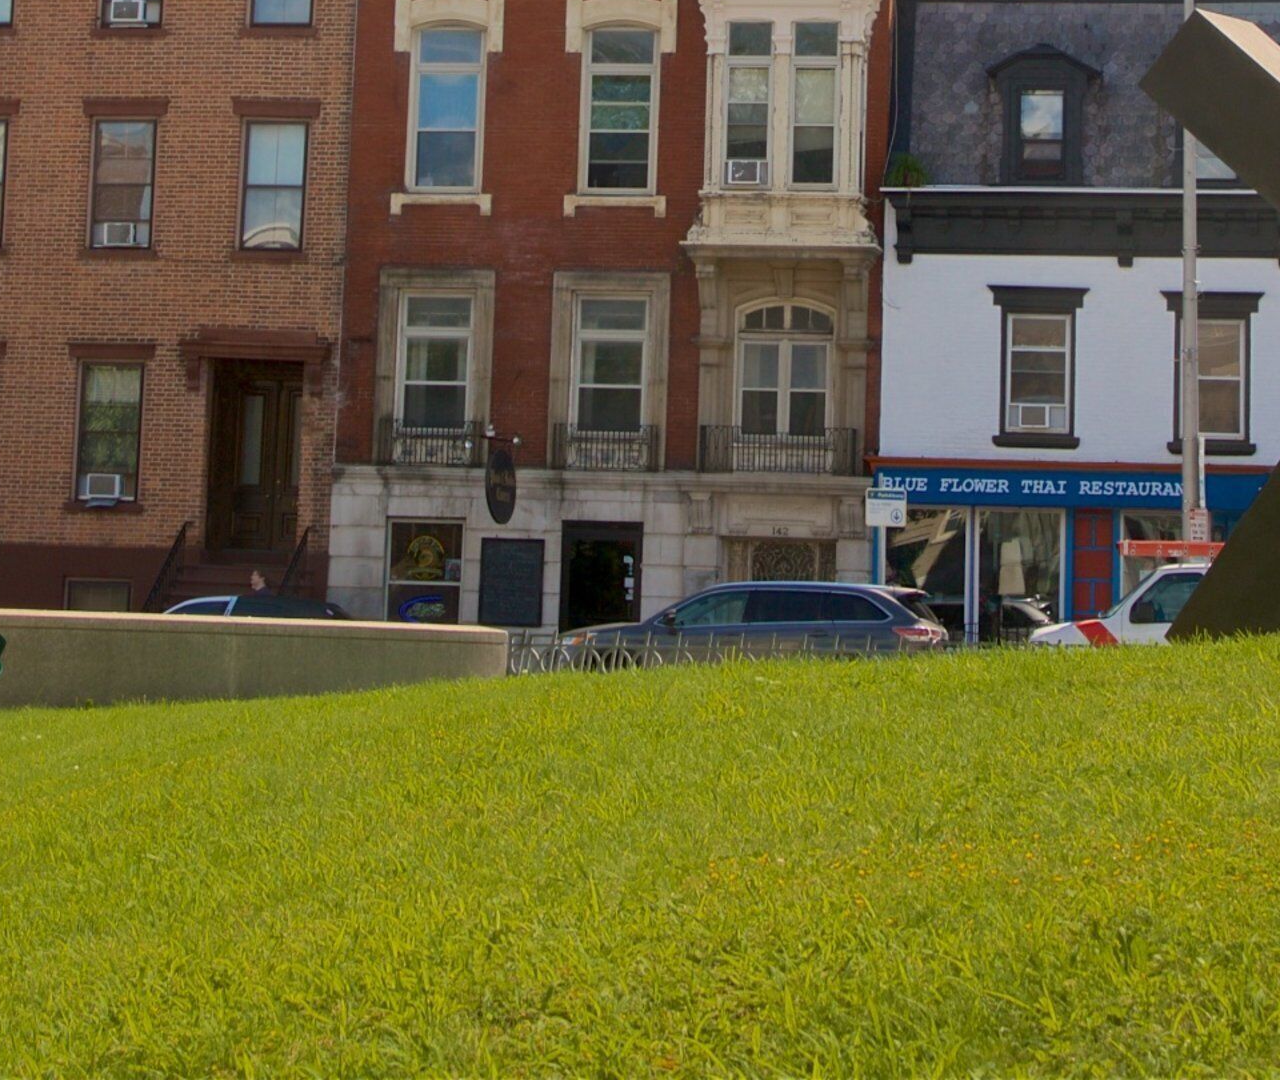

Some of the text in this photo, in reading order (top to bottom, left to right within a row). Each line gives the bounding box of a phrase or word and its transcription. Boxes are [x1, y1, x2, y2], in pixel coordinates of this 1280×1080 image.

[881, 476, 1184, 496] BLUE FLOWER THAI RESTAURAN
[772, 526, 789, 536] 142
